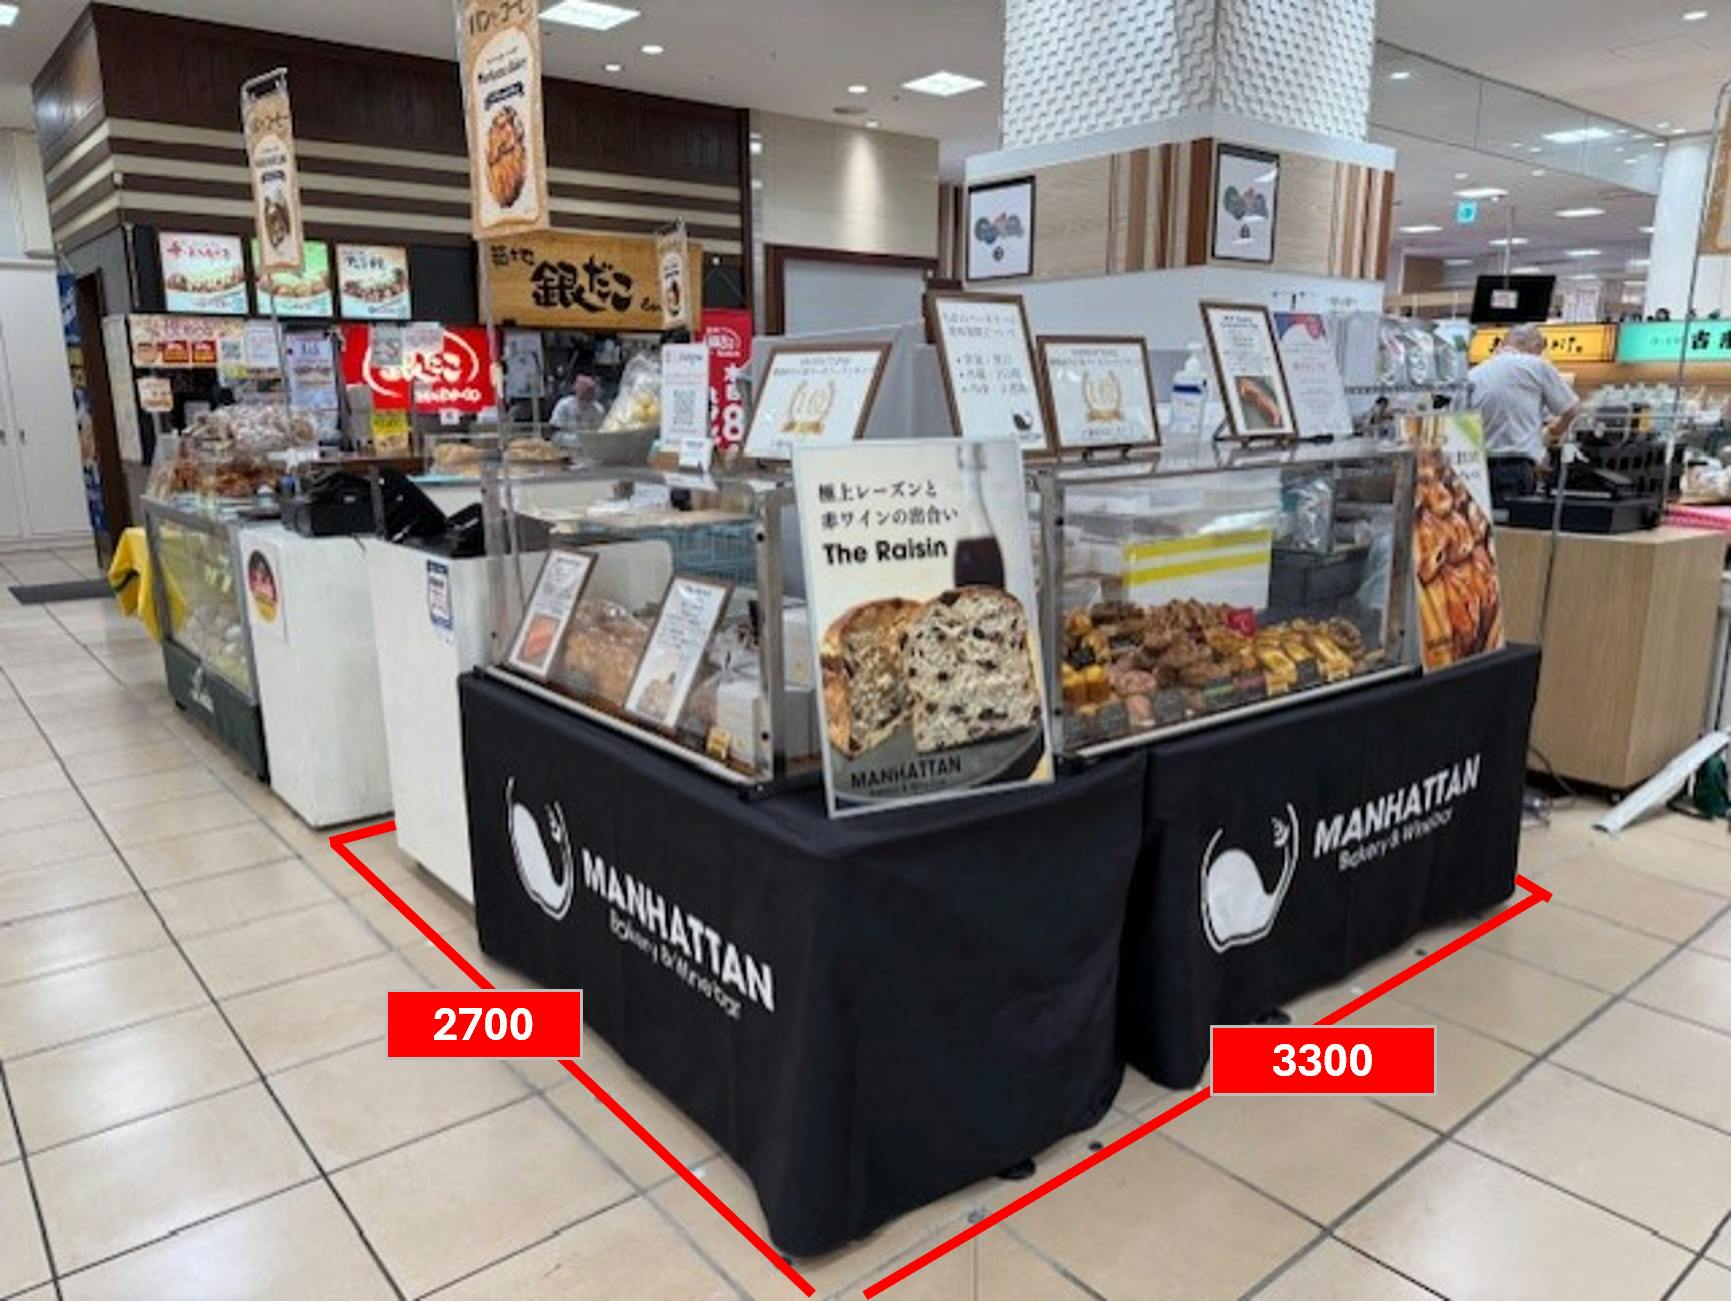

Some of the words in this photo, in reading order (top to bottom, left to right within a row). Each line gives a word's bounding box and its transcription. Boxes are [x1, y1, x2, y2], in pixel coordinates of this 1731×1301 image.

[530, 253, 633, 313] 銀だこ
[818, 480, 938, 503] 極上レーズンと
[821, 505, 959, 530] 赤ワインの出合い
[823, 542, 867, 566] The
[875, 537, 949, 563] Raisin
[850, 756, 962, 789] MANHATTAN
[1313, 753, 1481, 859] MANHATTAN
[582, 847, 775, 1013] MANHATTAN
